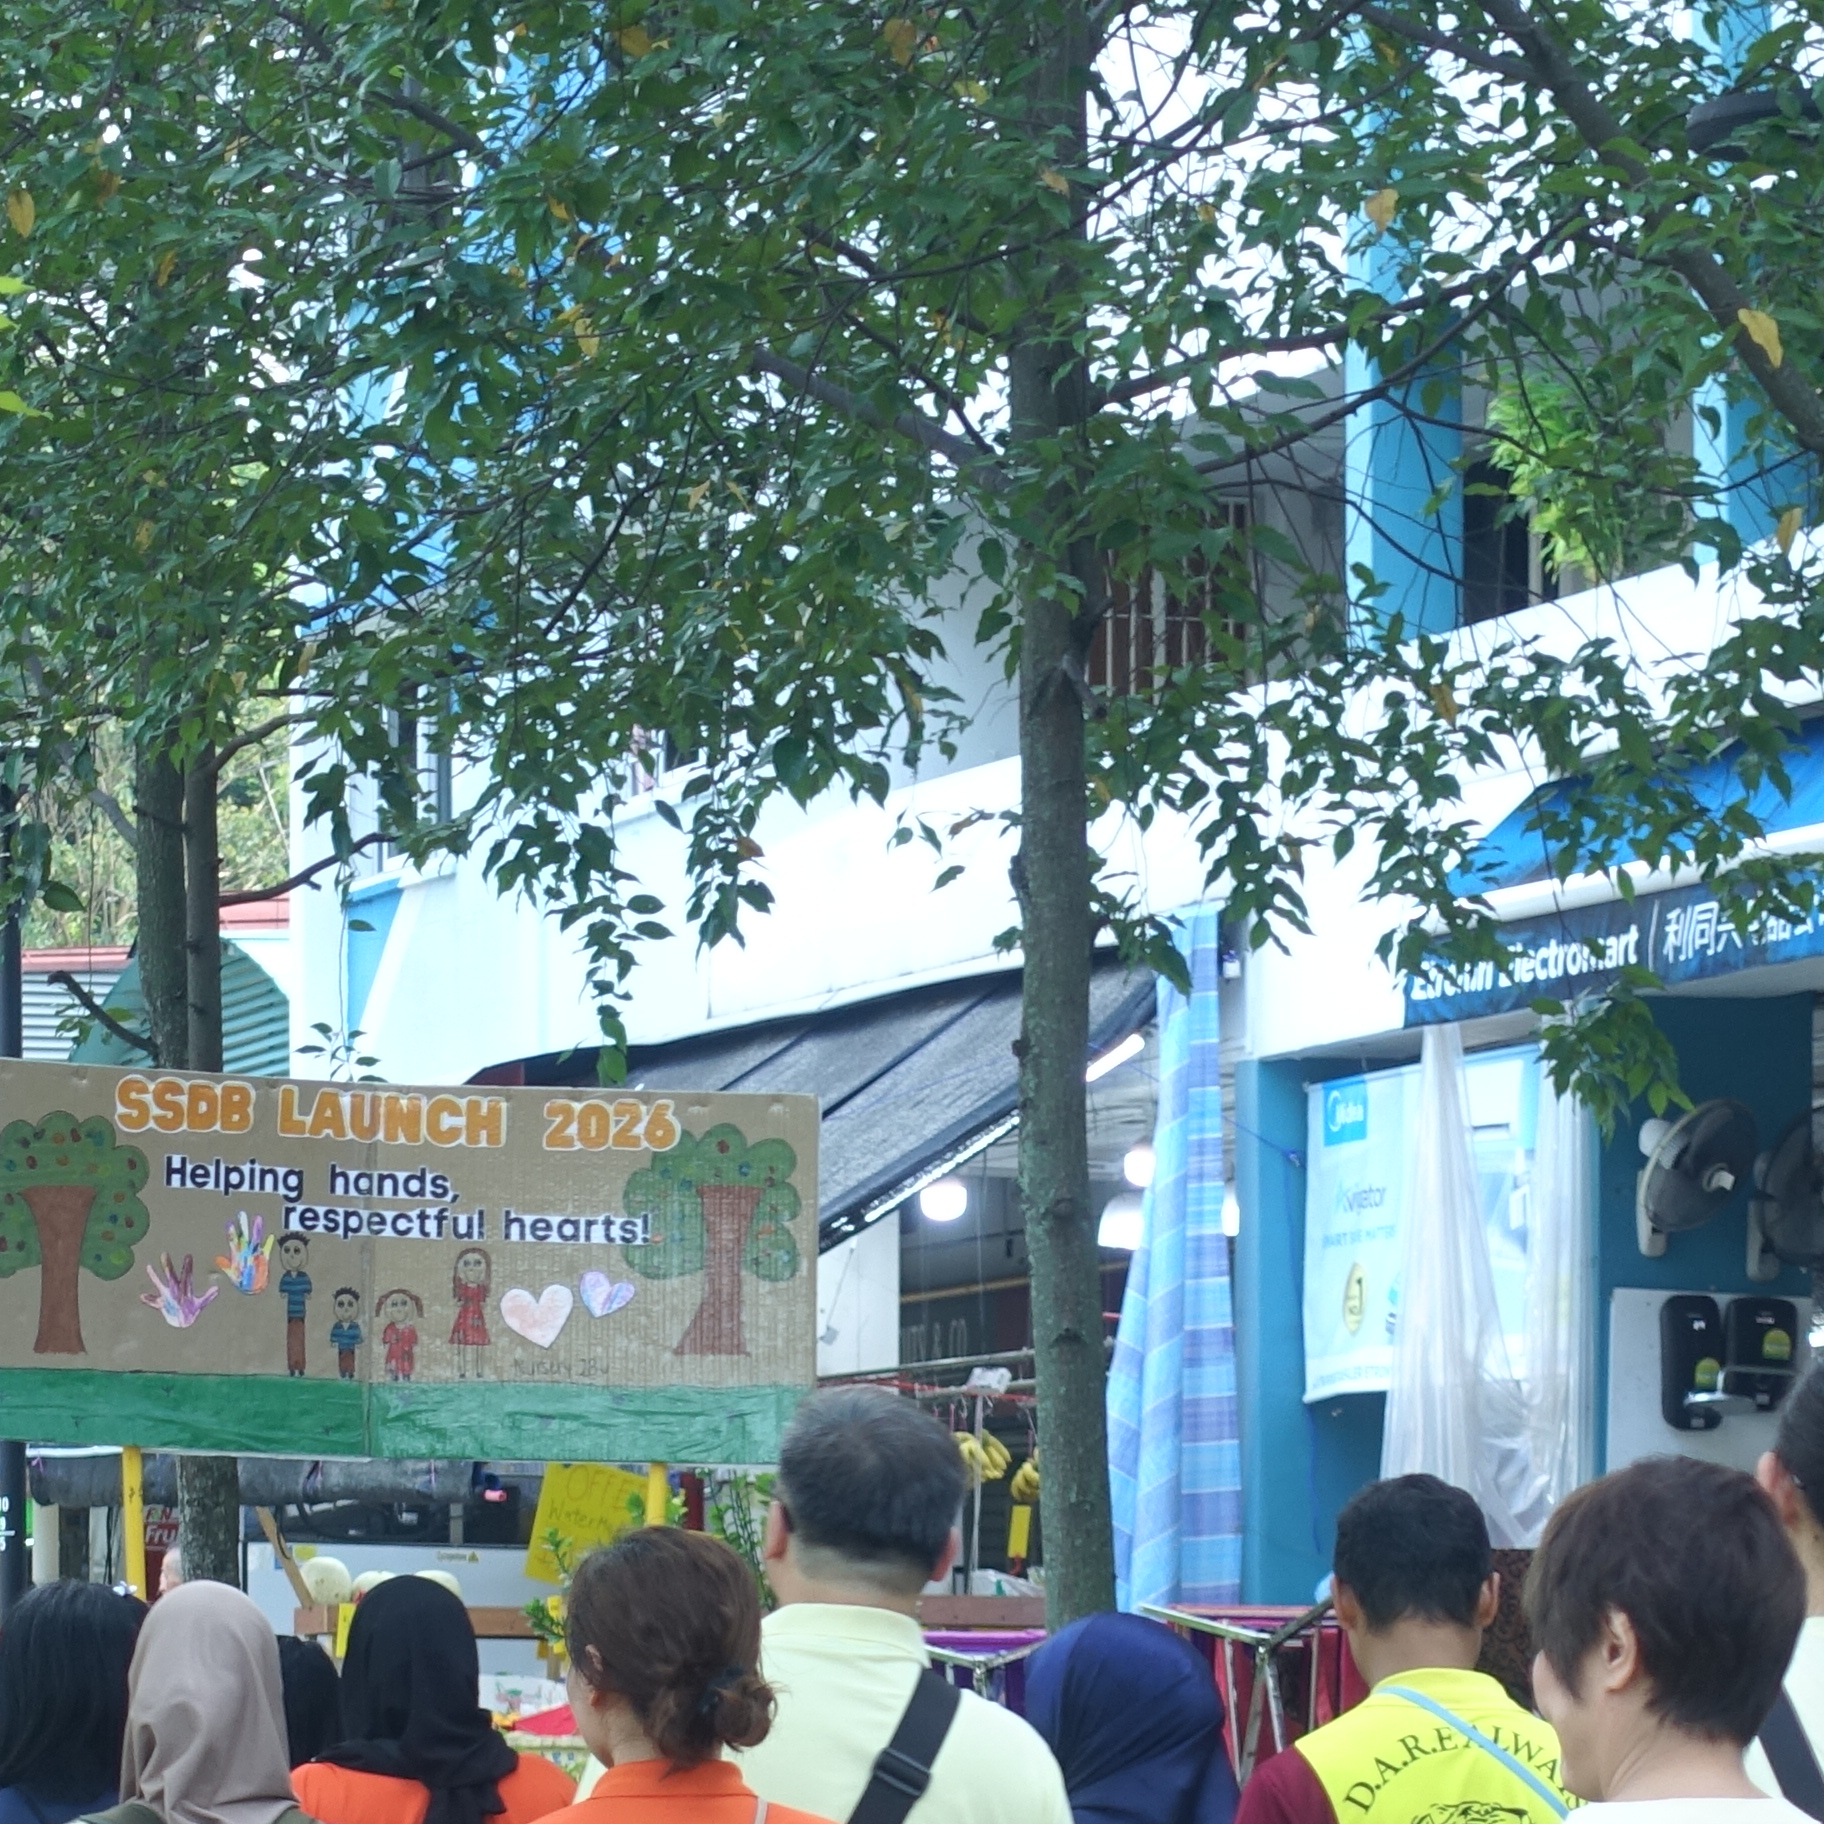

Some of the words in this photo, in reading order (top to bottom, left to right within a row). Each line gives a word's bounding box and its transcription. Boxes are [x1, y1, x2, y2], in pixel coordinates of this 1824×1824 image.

[115, 1075, 257, 1133] SSDB
[278, 1084, 506, 1148] LAUNCH
[543, 1098, 681, 1152] 2026
[165, 1156, 304, 1199] Helping
[329, 1164, 460, 1201] hands,
[283, 1204, 485, 1240] respectful
[504, 1211, 650, 1244] hearts!
